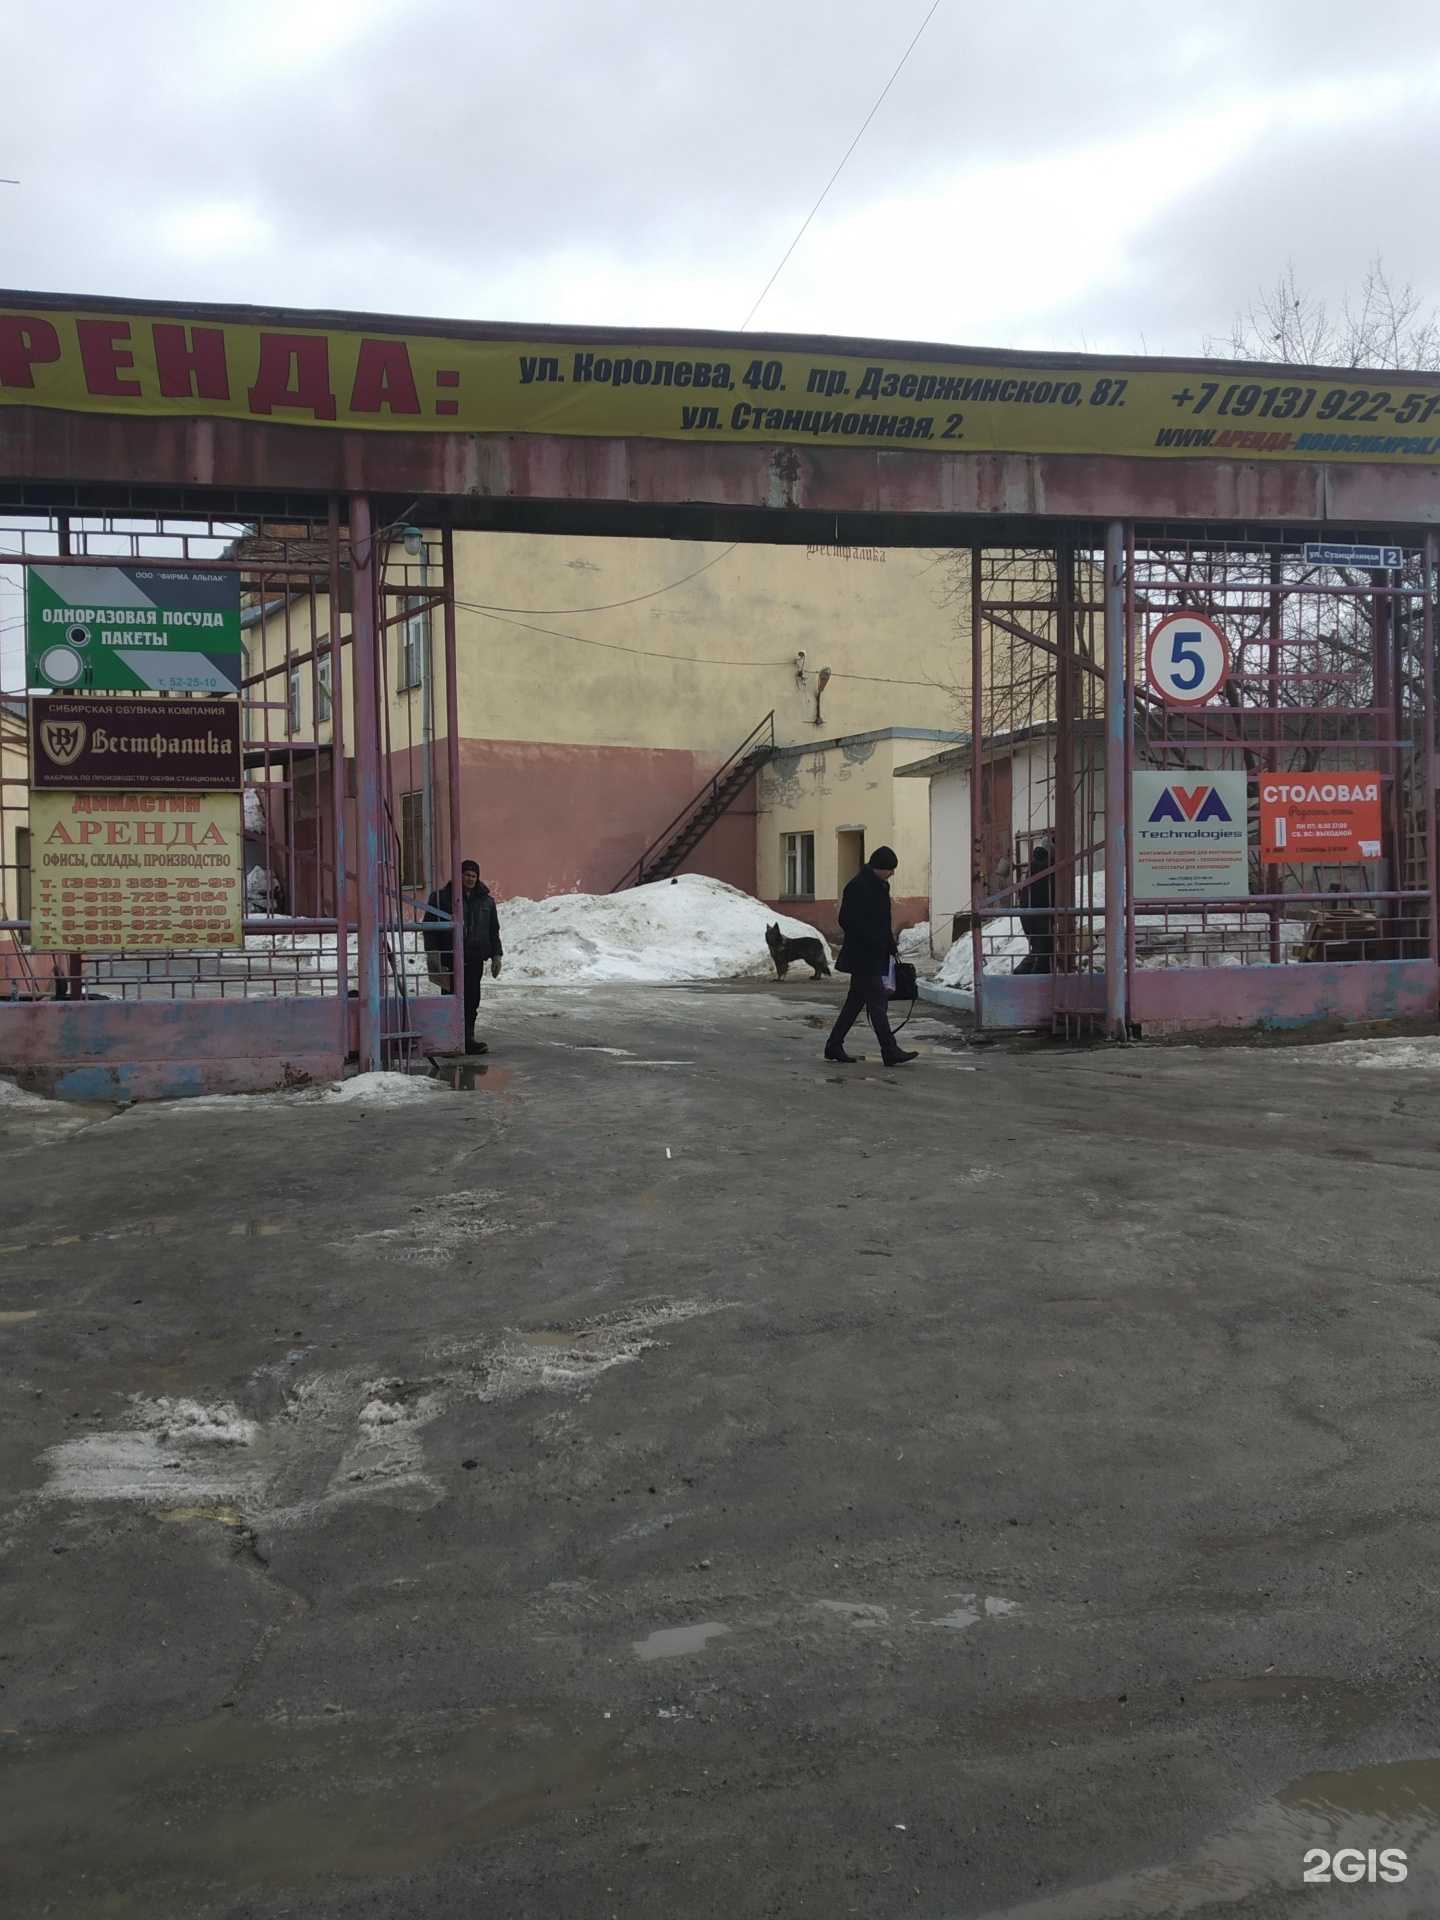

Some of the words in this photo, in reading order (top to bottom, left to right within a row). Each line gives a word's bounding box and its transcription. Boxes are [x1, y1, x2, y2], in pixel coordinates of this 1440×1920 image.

[519, 356, 564, 384] ул.
[572, 352, 735, 391] Королева,
[742, 360, 786, 391] 40.
[806, 368, 850, 396] пр.
[855, 367, 1083, 408] Дзержинского,
[1088, 378, 1128, 407] 87.
[1171, 382, 1219, 414] +7
[1217, 385, 1317, 419] (913)
[680, 405, 722, 430] ул.
[730, 402, 935, 440] Станционная,
[940, 413, 963, 439] 2.
[1388, 551, 1398, 565] 2
[42, 608, 157, 625] ОДНОРАЗОВАЯ
[162, 611, 224, 627] ПОСУДА
[101, 631, 168, 646] ПАКЕТЫ
[1169, 631, 1205, 690] 5
[48, 704, 113, 715] СИБИРСКАЯ
[115, 705, 166, 716] ОБУВНАЯ
[167, 706, 225, 716] КОМПАНИЯ
[91, 729, 232, 758] Вестфалика
[1148, 785, 1232, 822] AVA
[1263, 784, 1378, 803] СТОЛОВАЯ
[72, 794, 201, 814] ДИНАСТИЯ
[43, 820, 228, 851] АРЕНДА
[1138, 829, 1243, 840] Technologies
[43, 854, 88, 868] ОФИСЫ,
[90, 854, 142, 869] СКЛАДЫ,
[143, 854, 231, 869] ПРОИЗВОДСТВО
